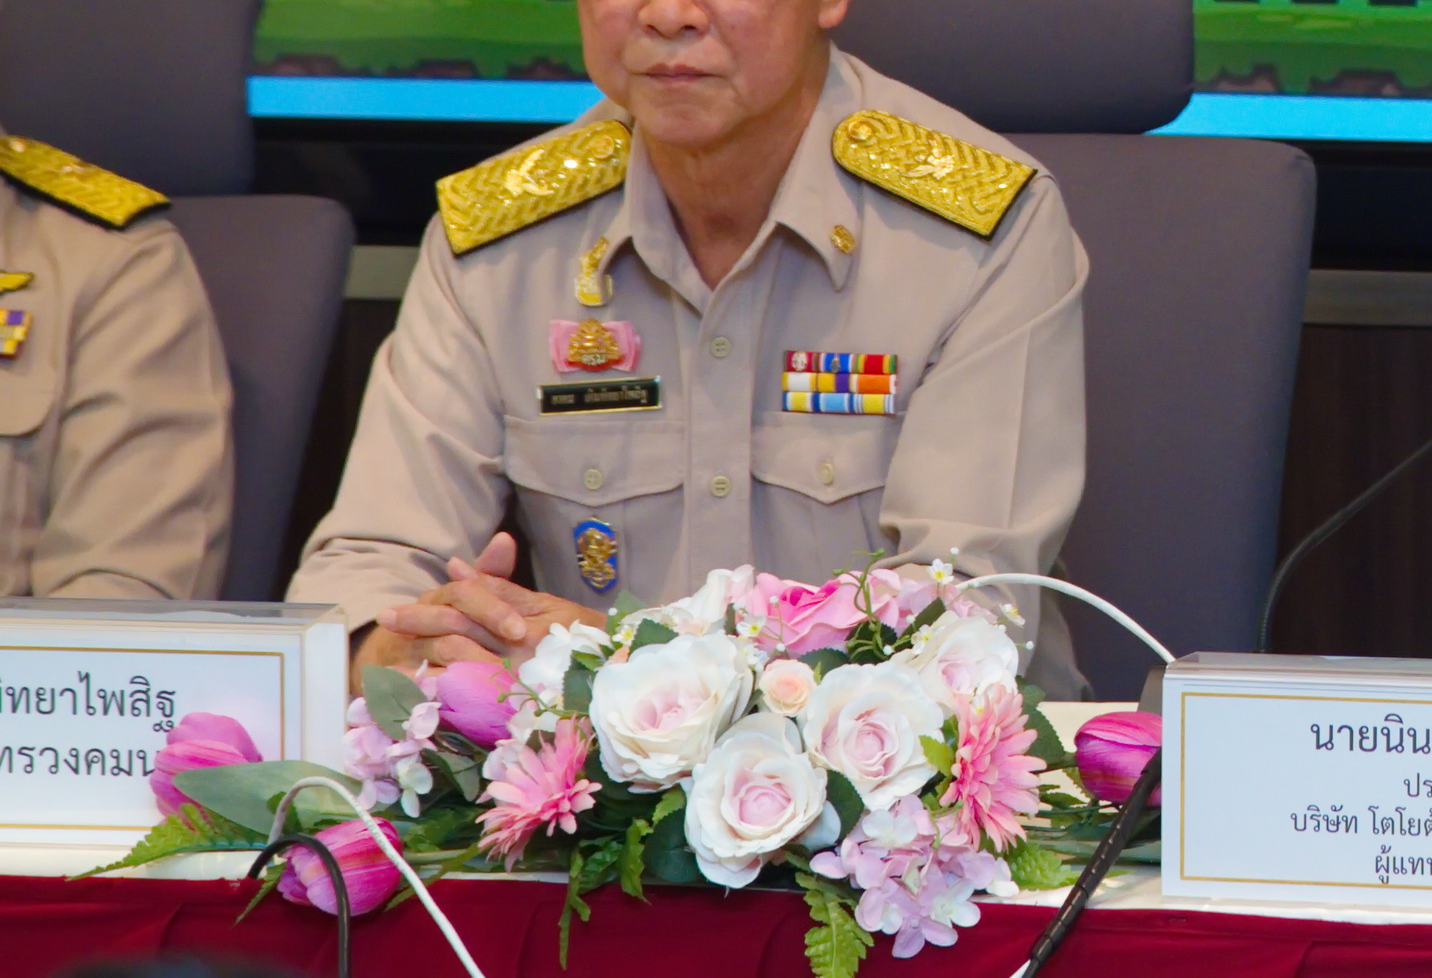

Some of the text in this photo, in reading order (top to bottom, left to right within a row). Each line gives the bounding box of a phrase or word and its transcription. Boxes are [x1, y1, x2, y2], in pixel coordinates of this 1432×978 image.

[0, 670, 177, 733] ทยาไพสิฐ
[1289, 803, 1359, 835] บริษัท
